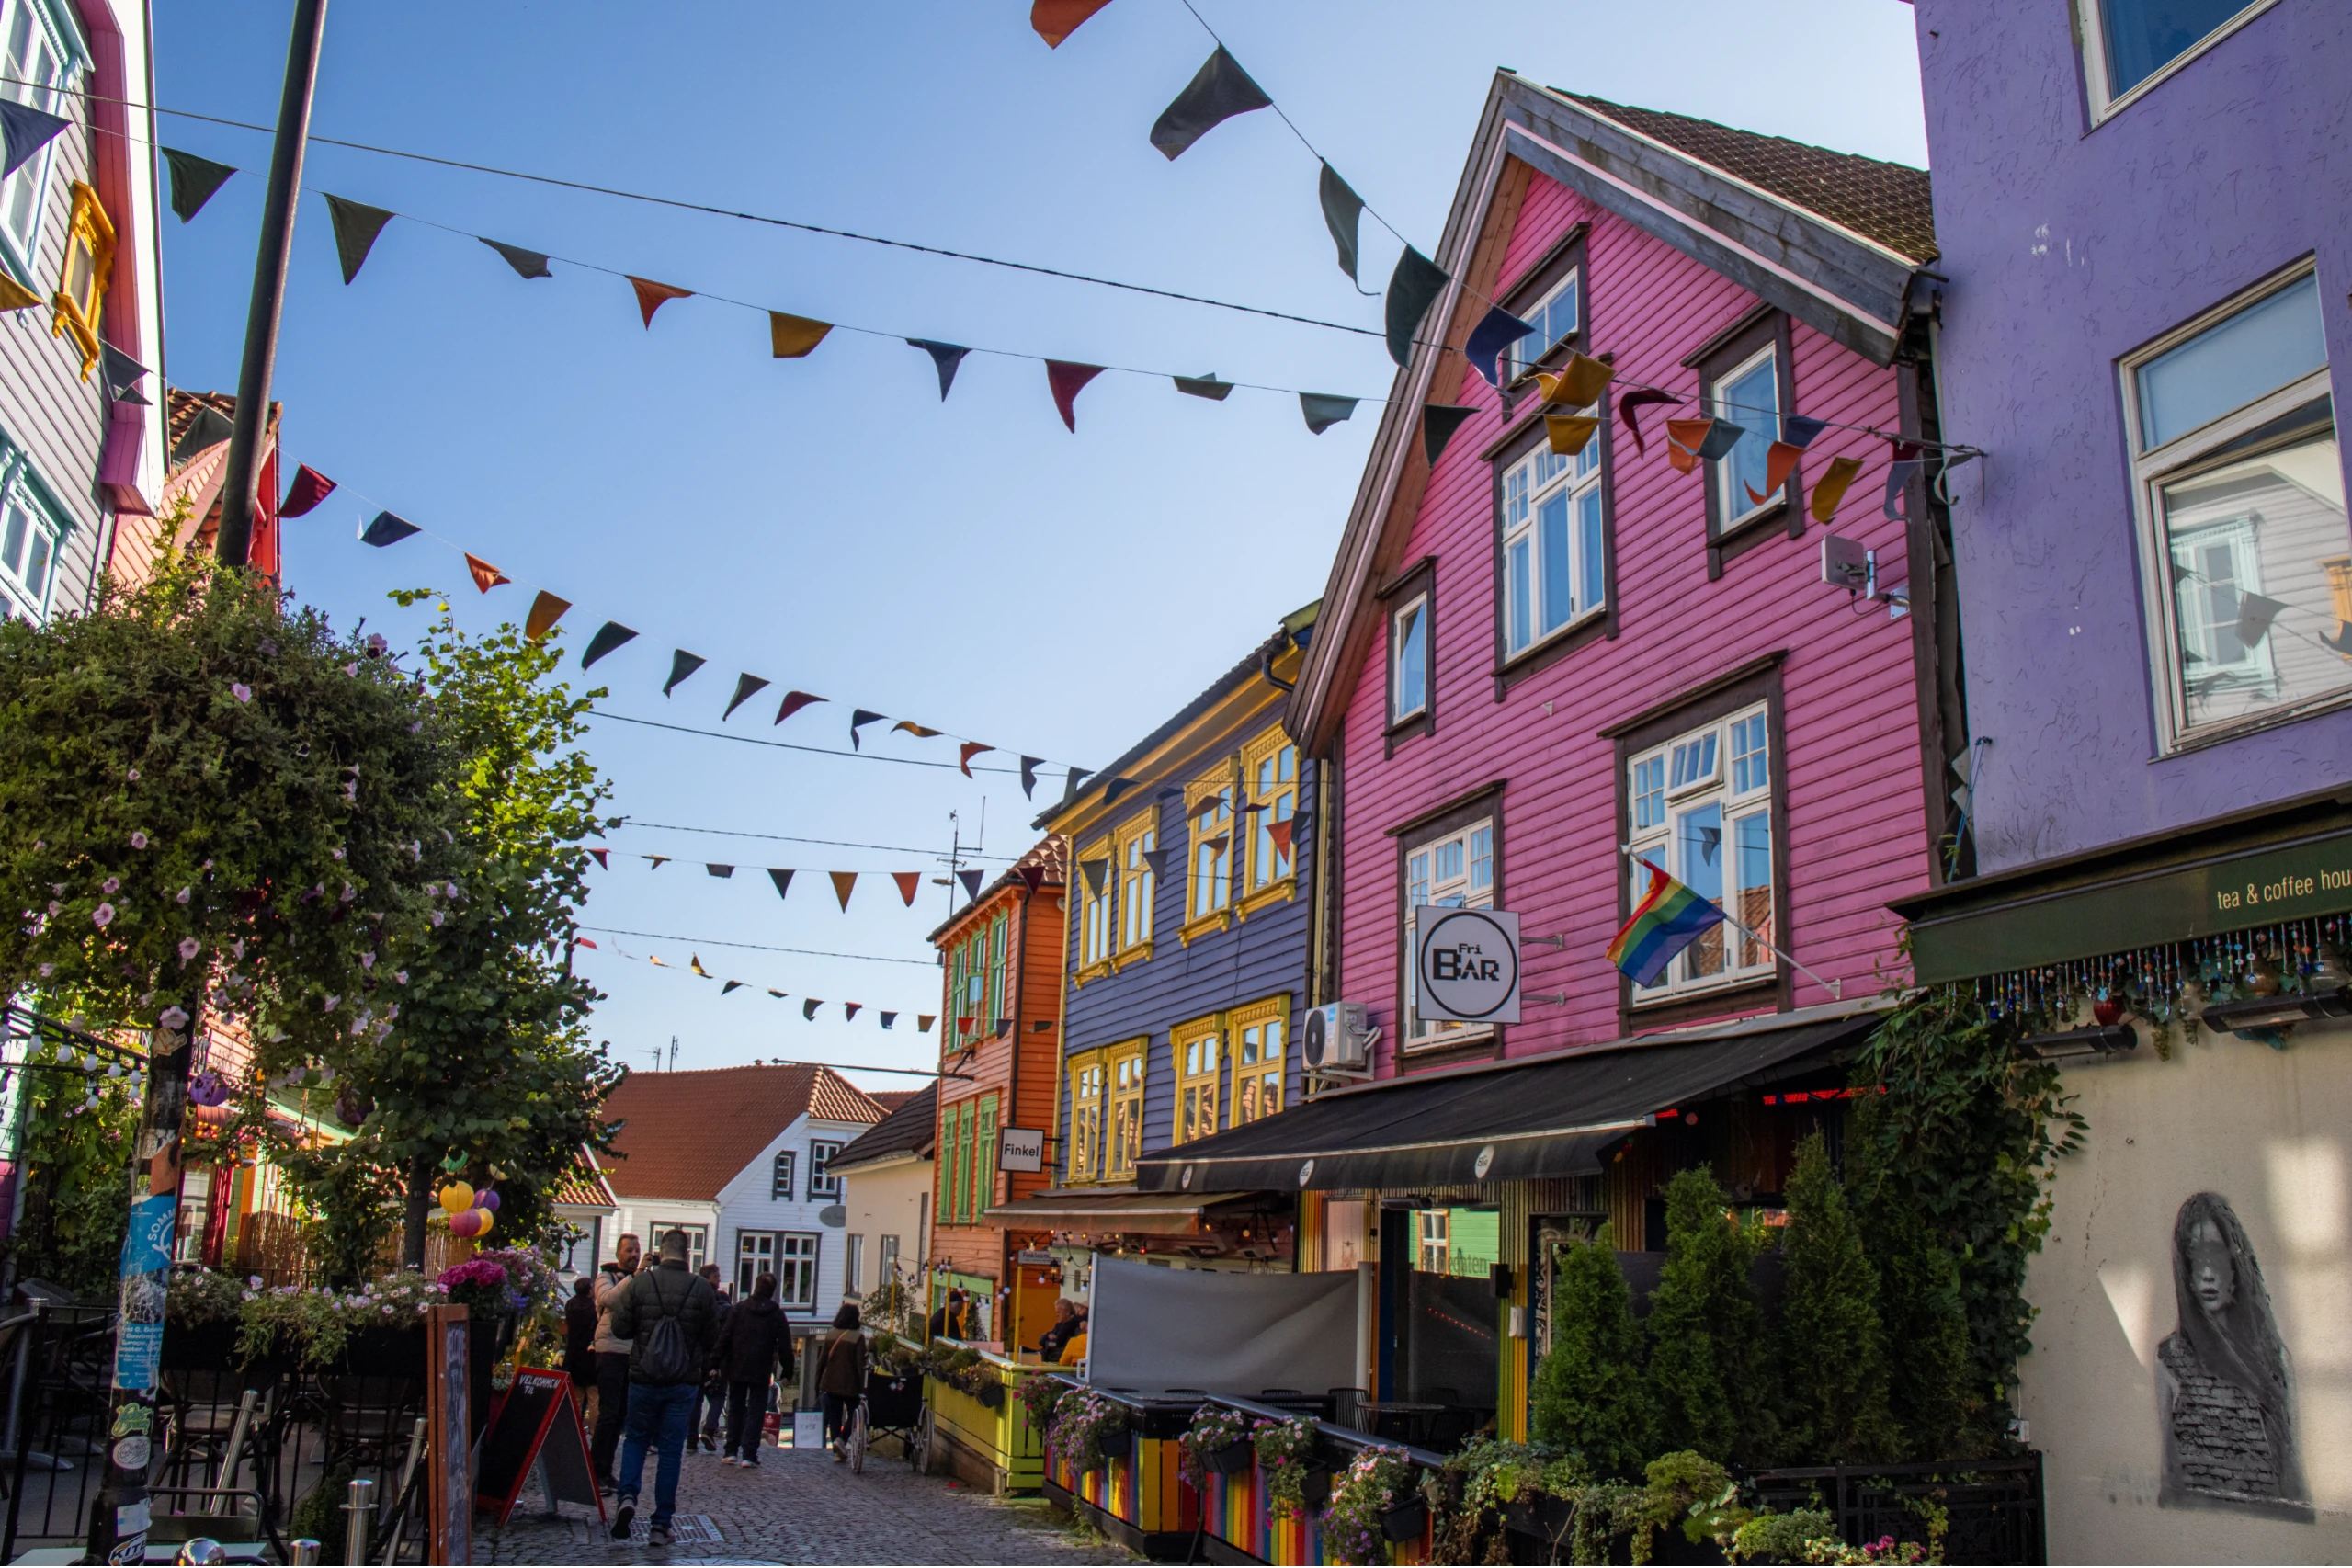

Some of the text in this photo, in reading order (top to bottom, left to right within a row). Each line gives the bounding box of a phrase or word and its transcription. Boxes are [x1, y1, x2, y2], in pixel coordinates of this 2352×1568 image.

[2217, 891, 2241, 910] tea
[2246, 883, 2259, 904] &
[2263, 876, 2314, 902] coffee
[1458, 943, 1483, 955] Fri
[1432, 948, 1500, 981] BAR
[1004, 1143, 1040, 1157] Finkel
[519, 1374, 561, 1389] VELKOMMEN
[524, 1385, 534, 1395] TIL
